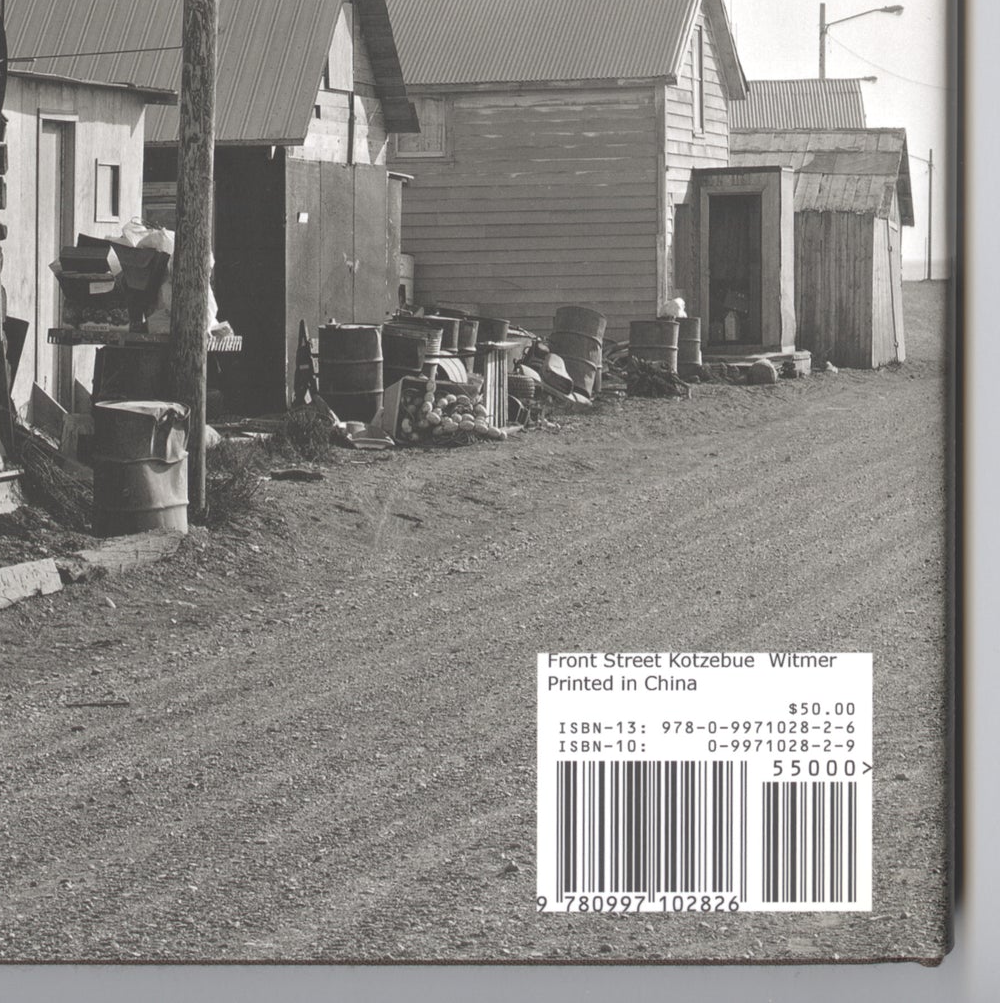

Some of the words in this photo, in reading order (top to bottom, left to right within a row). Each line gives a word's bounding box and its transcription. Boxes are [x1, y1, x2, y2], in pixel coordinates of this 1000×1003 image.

[548, 653, 598, 668] Front
[603, 653, 662, 668] Street
[669, 653, 755, 668] Kotzebue
[768, 653, 838, 668] Witmer
[548, 675, 614, 691] Printed
[621, 676, 637, 691] in
[644, 675, 697, 691] China
[788, 702, 855, 716] $50.00
[559, 721, 647, 734] ISBN-13:
[662, 720, 855, 734] 978-0-9971028-2-6
[559, 739, 647, 753] ISBN-10:
[708, 739, 855, 753] 0-9971028-2-9
